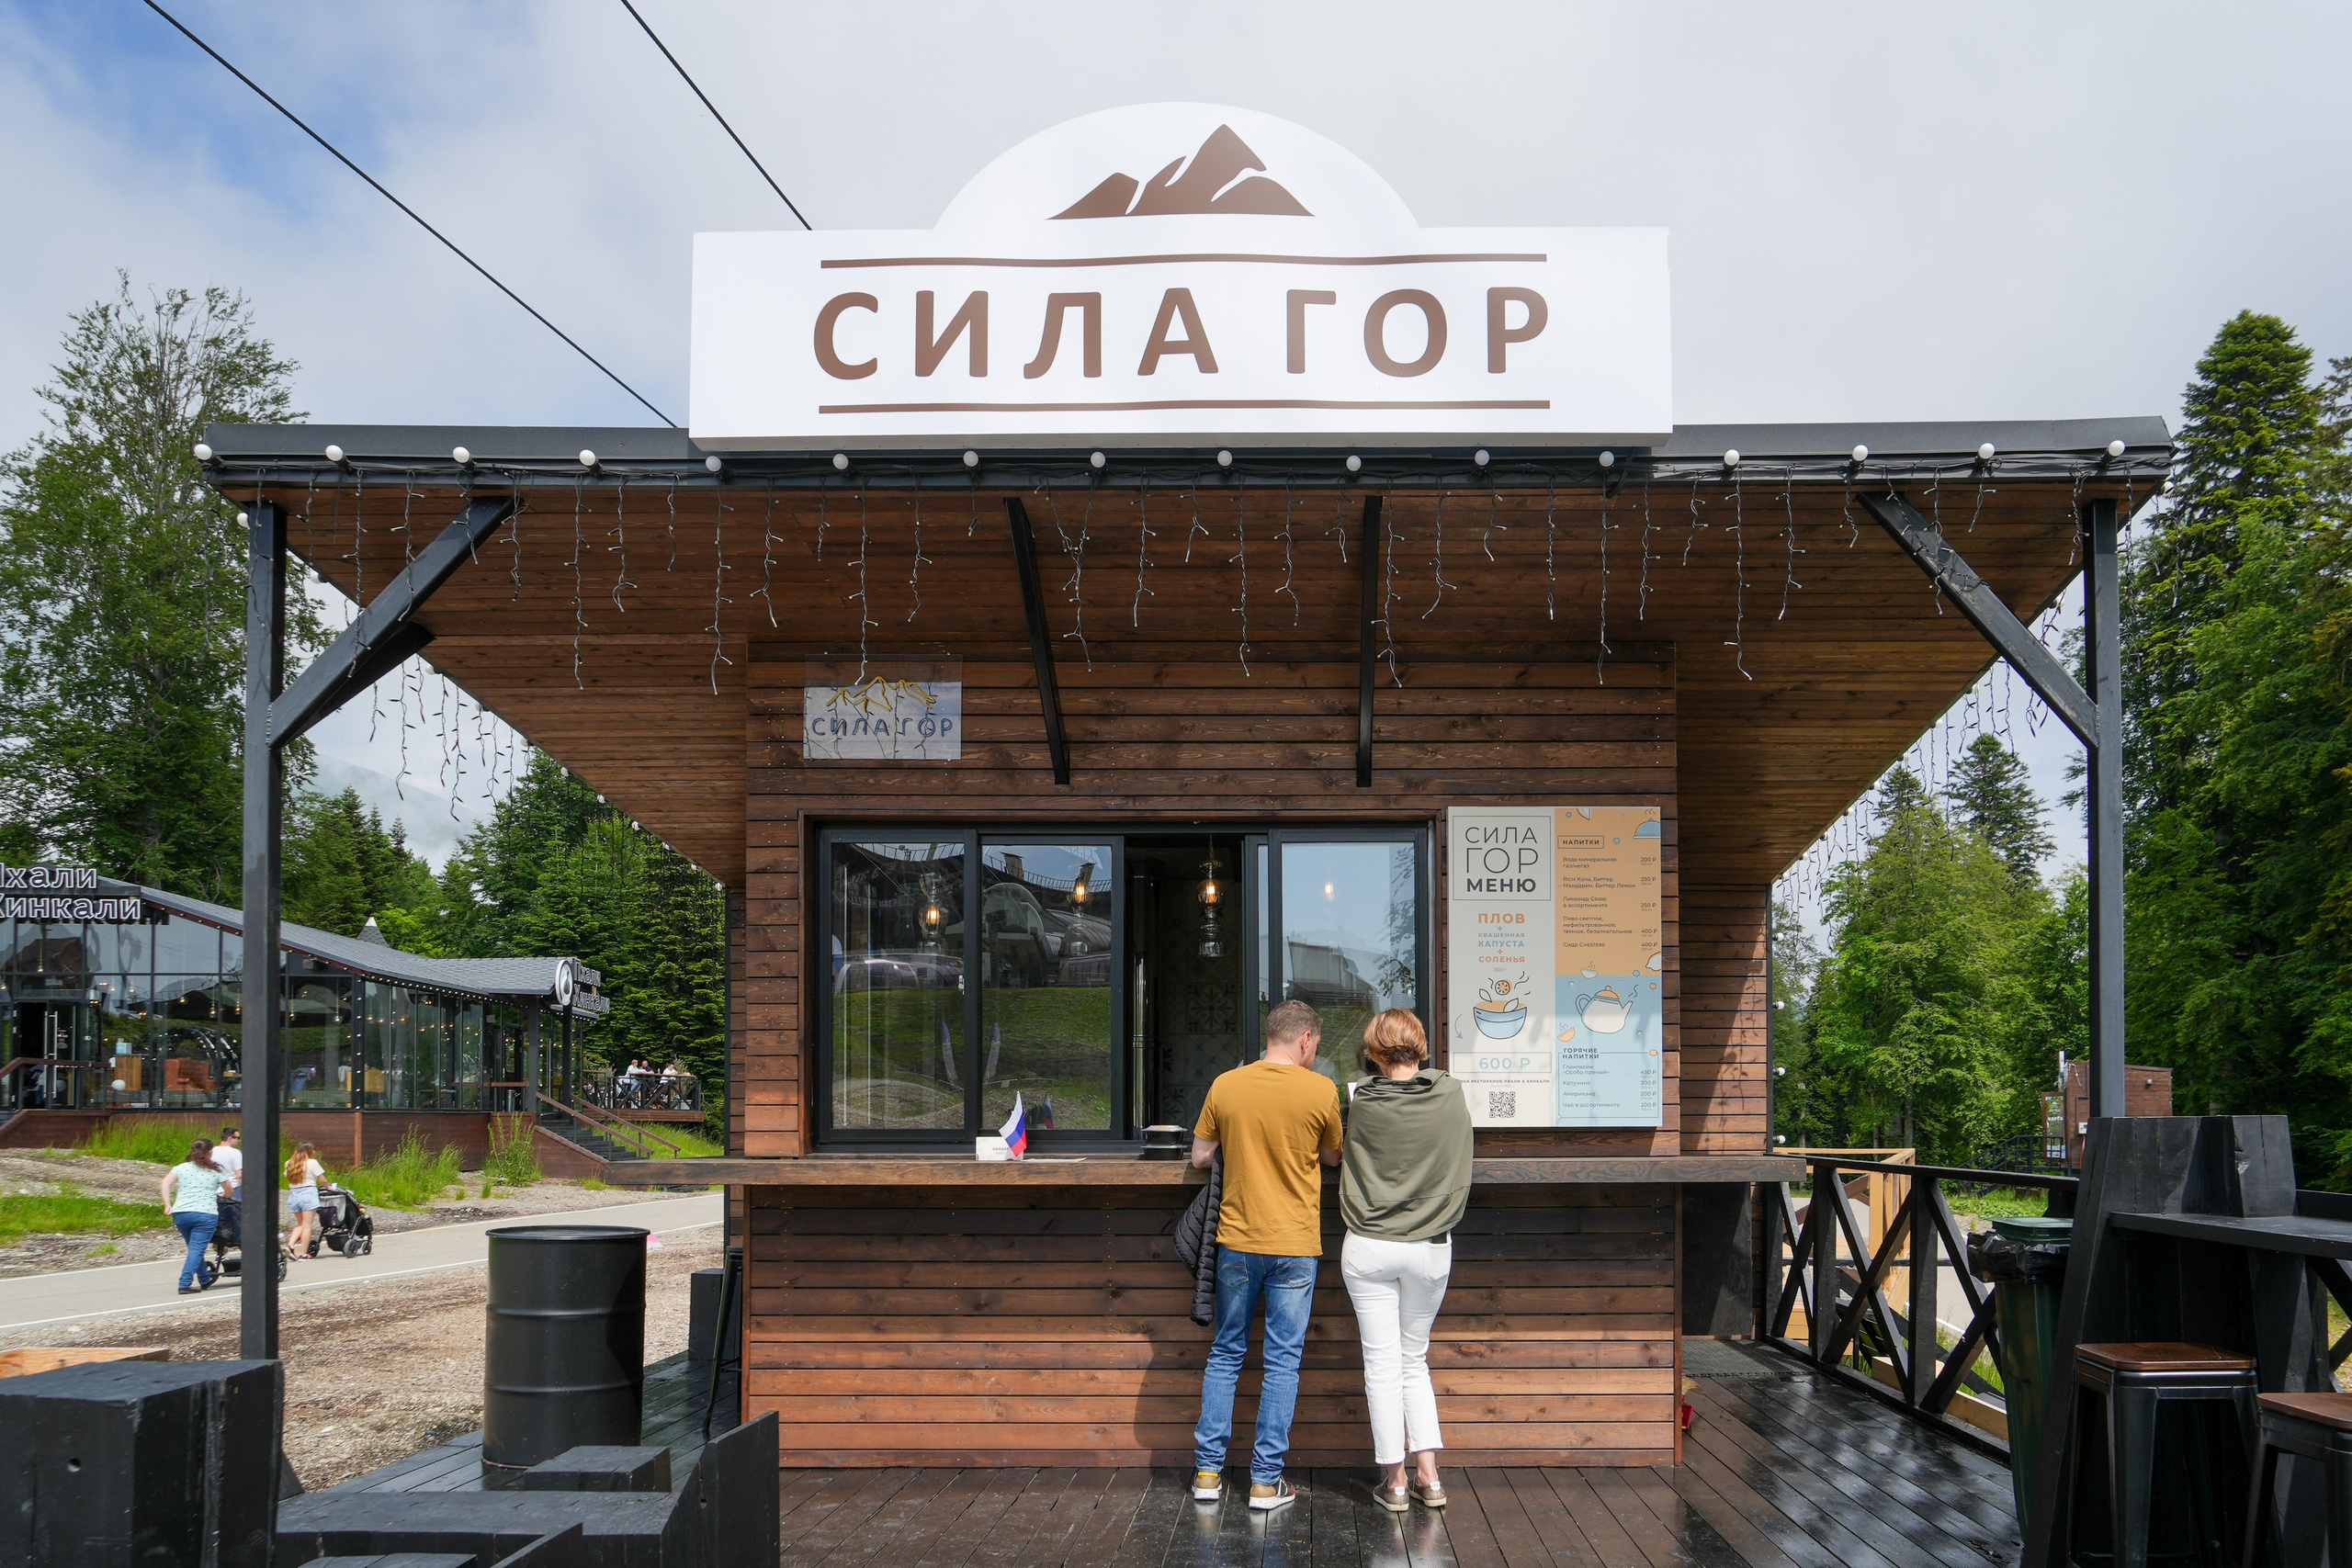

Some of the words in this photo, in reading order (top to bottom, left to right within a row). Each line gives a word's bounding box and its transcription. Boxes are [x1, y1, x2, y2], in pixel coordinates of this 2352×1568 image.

[812, 286, 1219, 379] СИЛА
[1285, 286, 1549, 378] ГОР
[811, 717, 889, 736] СИЛА
[902, 717, 953, 737] ГОР
[1464, 827, 1538, 843] СИЛА
[1466, 848, 1538, 874] ГОР
[1466, 878, 1536, 893] МЕНЮ
[1478, 913, 1525, 924] ПЛОВ
[1479, 1057, 1511, 1069] 600
